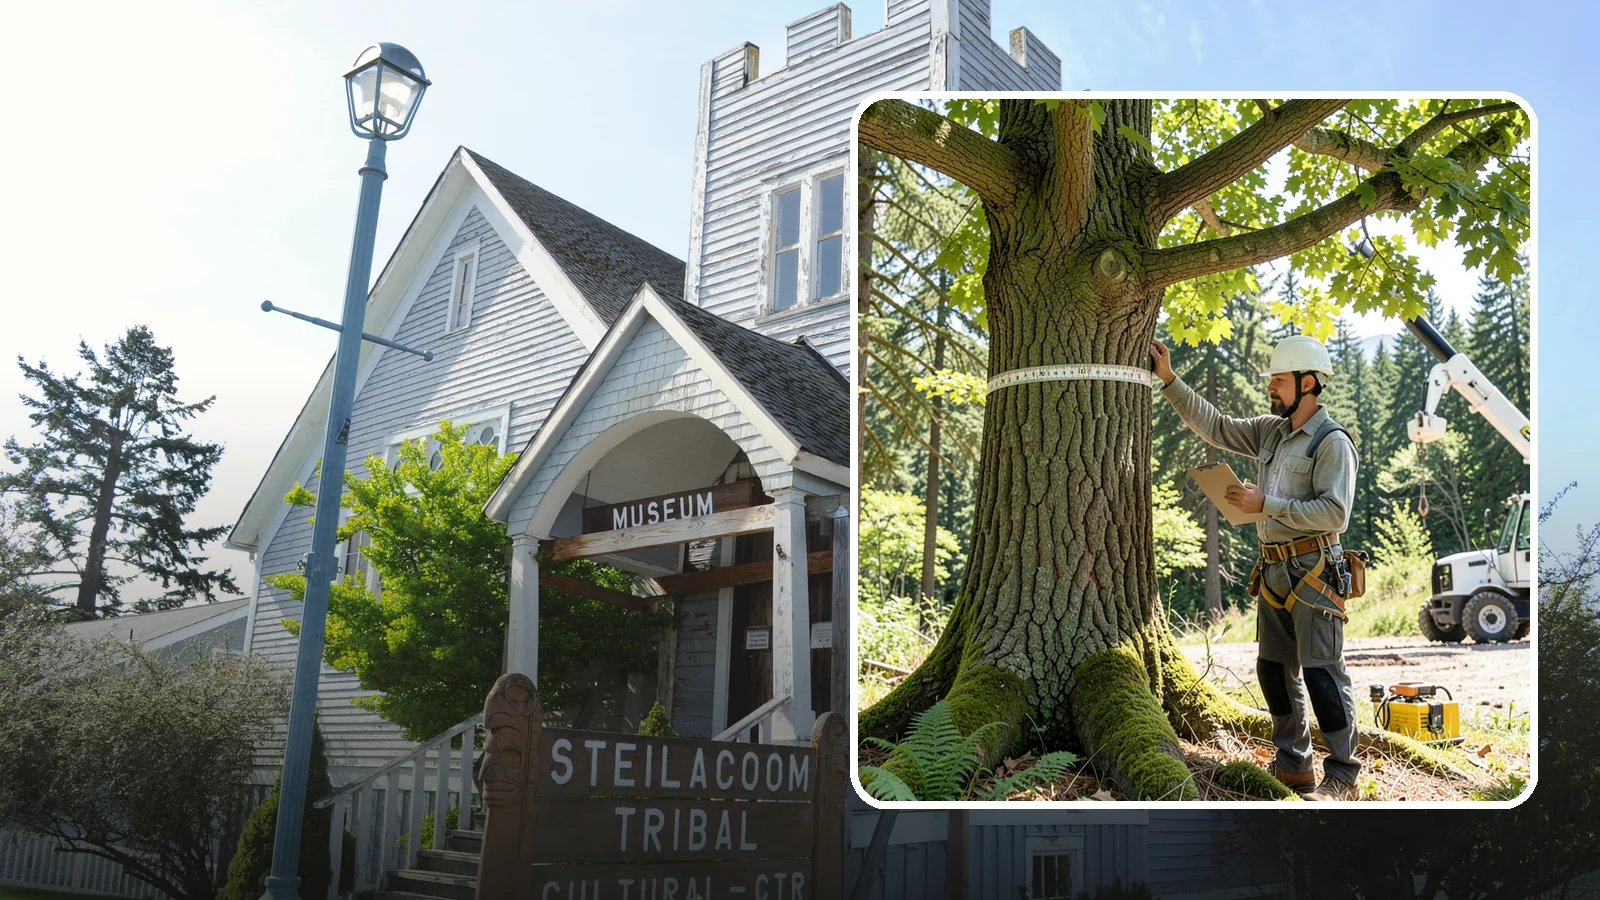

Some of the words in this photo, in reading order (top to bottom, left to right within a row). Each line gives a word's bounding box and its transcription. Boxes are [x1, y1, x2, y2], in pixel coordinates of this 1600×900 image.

[613, 491, 714, 530] MUSEUM
[551, 739, 809, 791] STEILACOOM
[615, 807, 758, 851] TRIBAL
